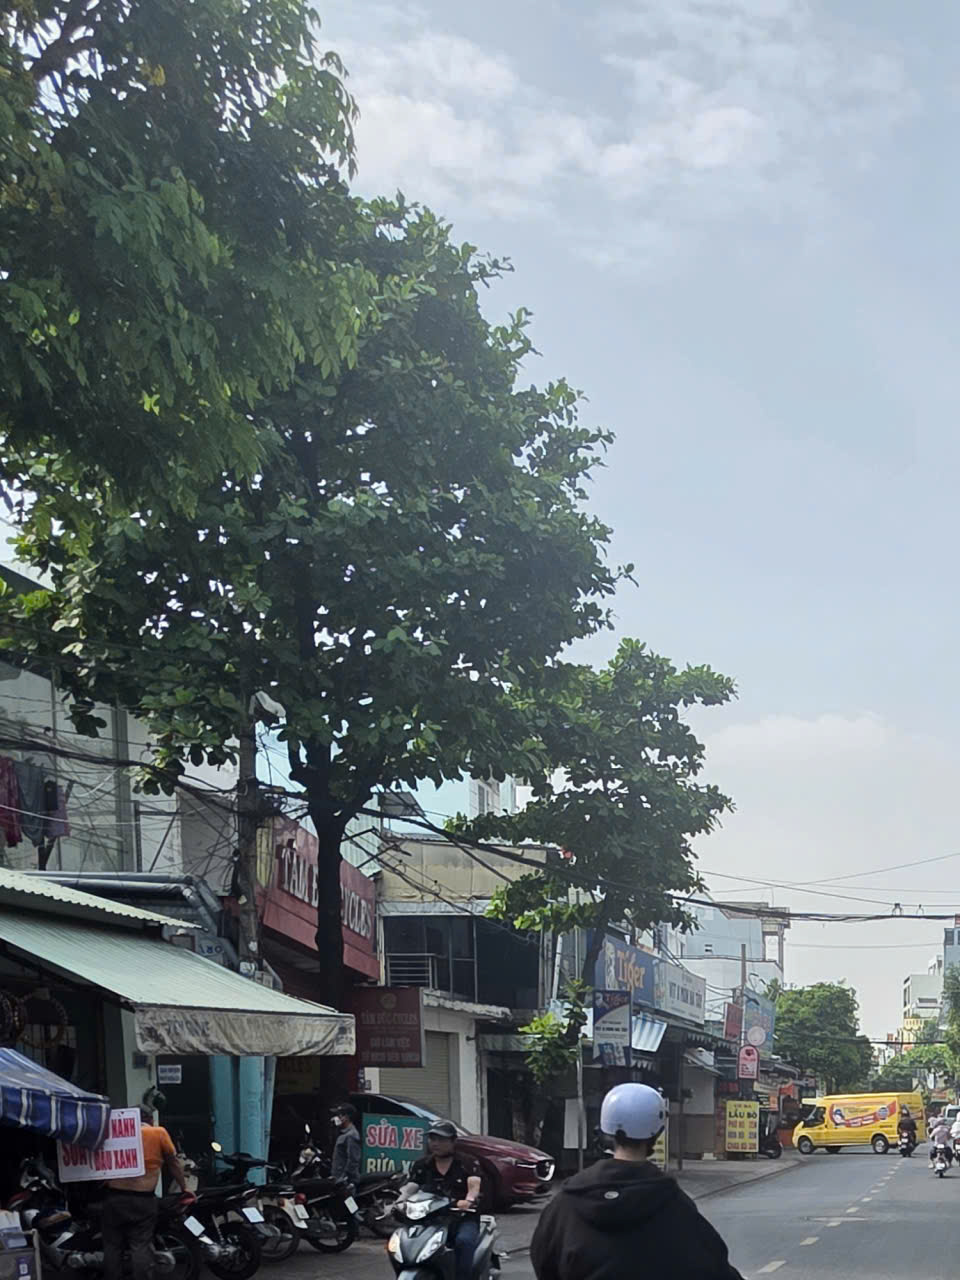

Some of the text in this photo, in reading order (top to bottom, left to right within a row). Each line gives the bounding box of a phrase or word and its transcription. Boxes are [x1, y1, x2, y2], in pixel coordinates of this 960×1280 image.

[340, 882, 373, 939] YCLES
[616, 950, 646, 993] Tiger
[366, 1118, 424, 1150] SỬA XE
